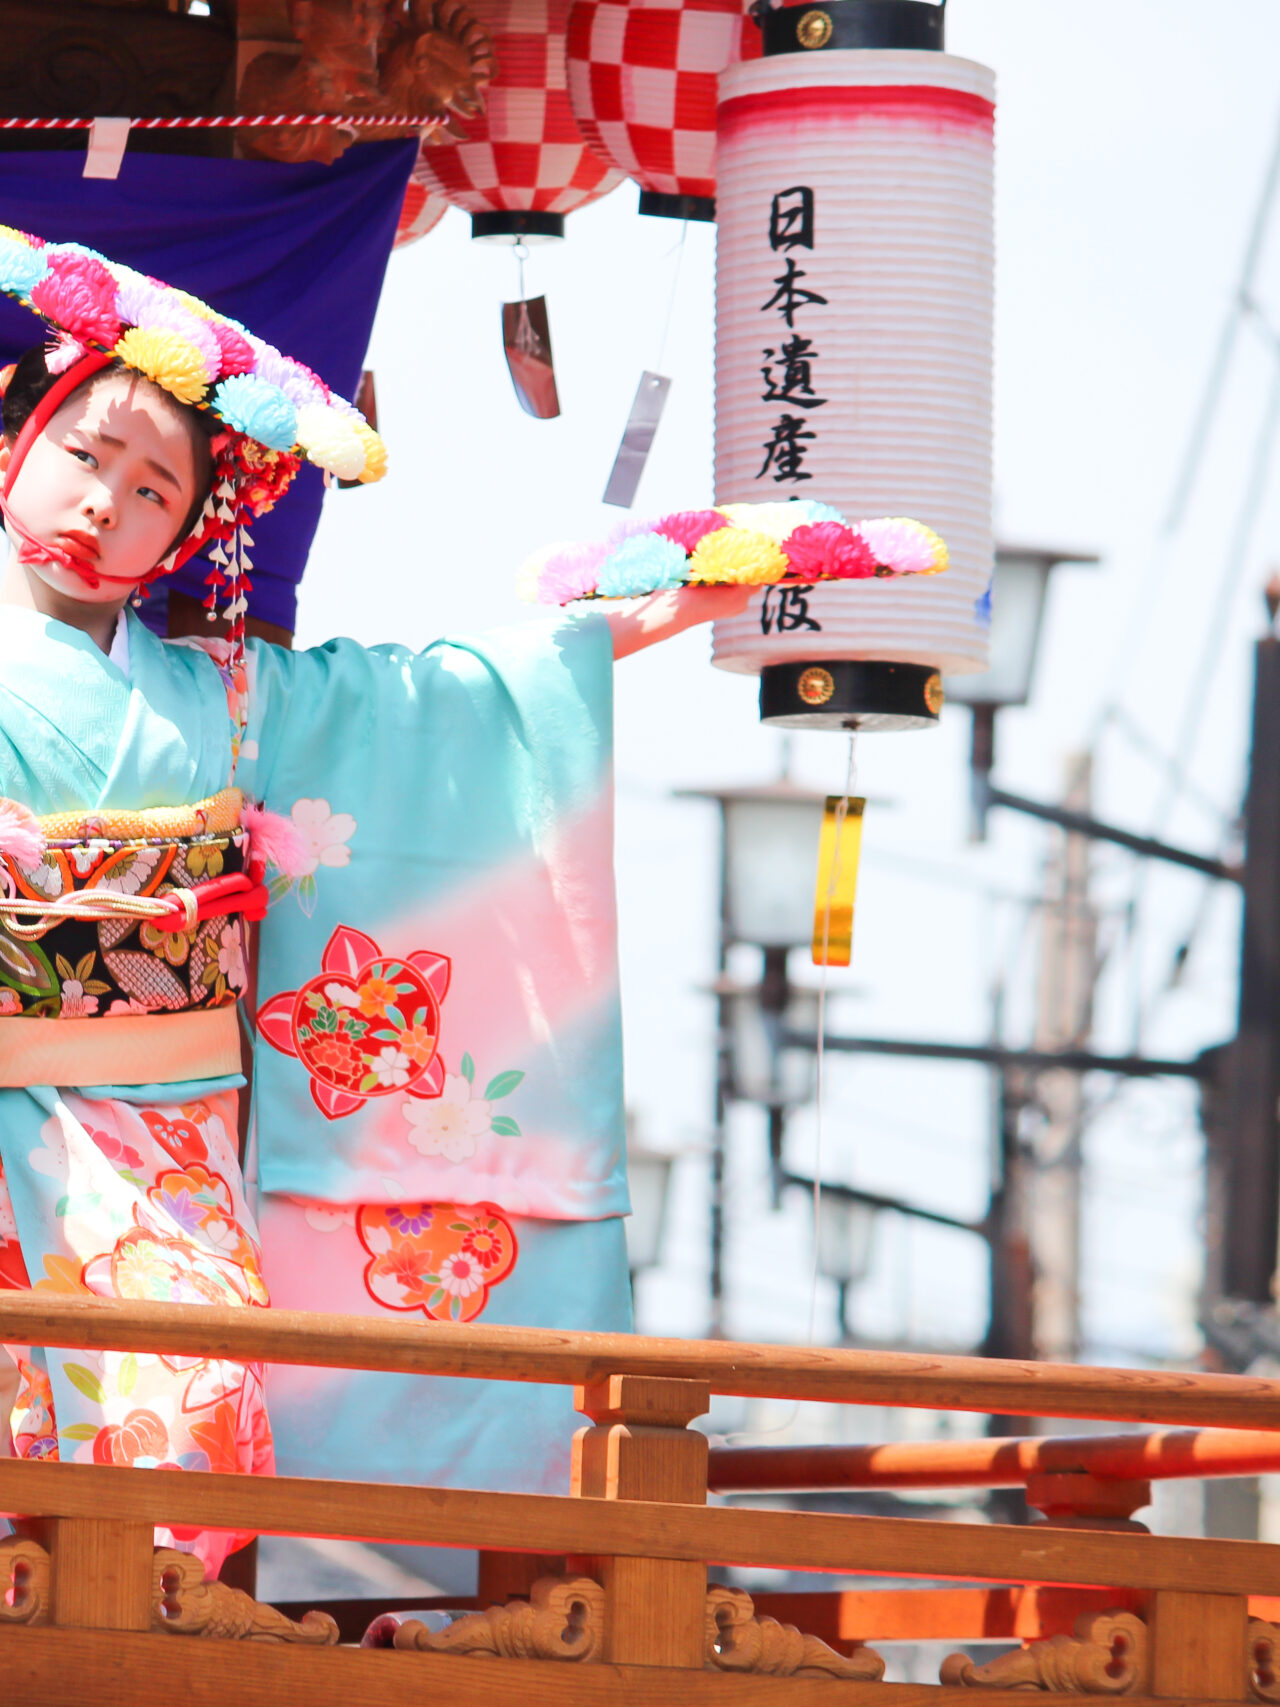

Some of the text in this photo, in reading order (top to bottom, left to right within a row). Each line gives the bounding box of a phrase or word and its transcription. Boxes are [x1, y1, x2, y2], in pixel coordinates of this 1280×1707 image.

[754, 186, 829, 636] 日本遺産波
